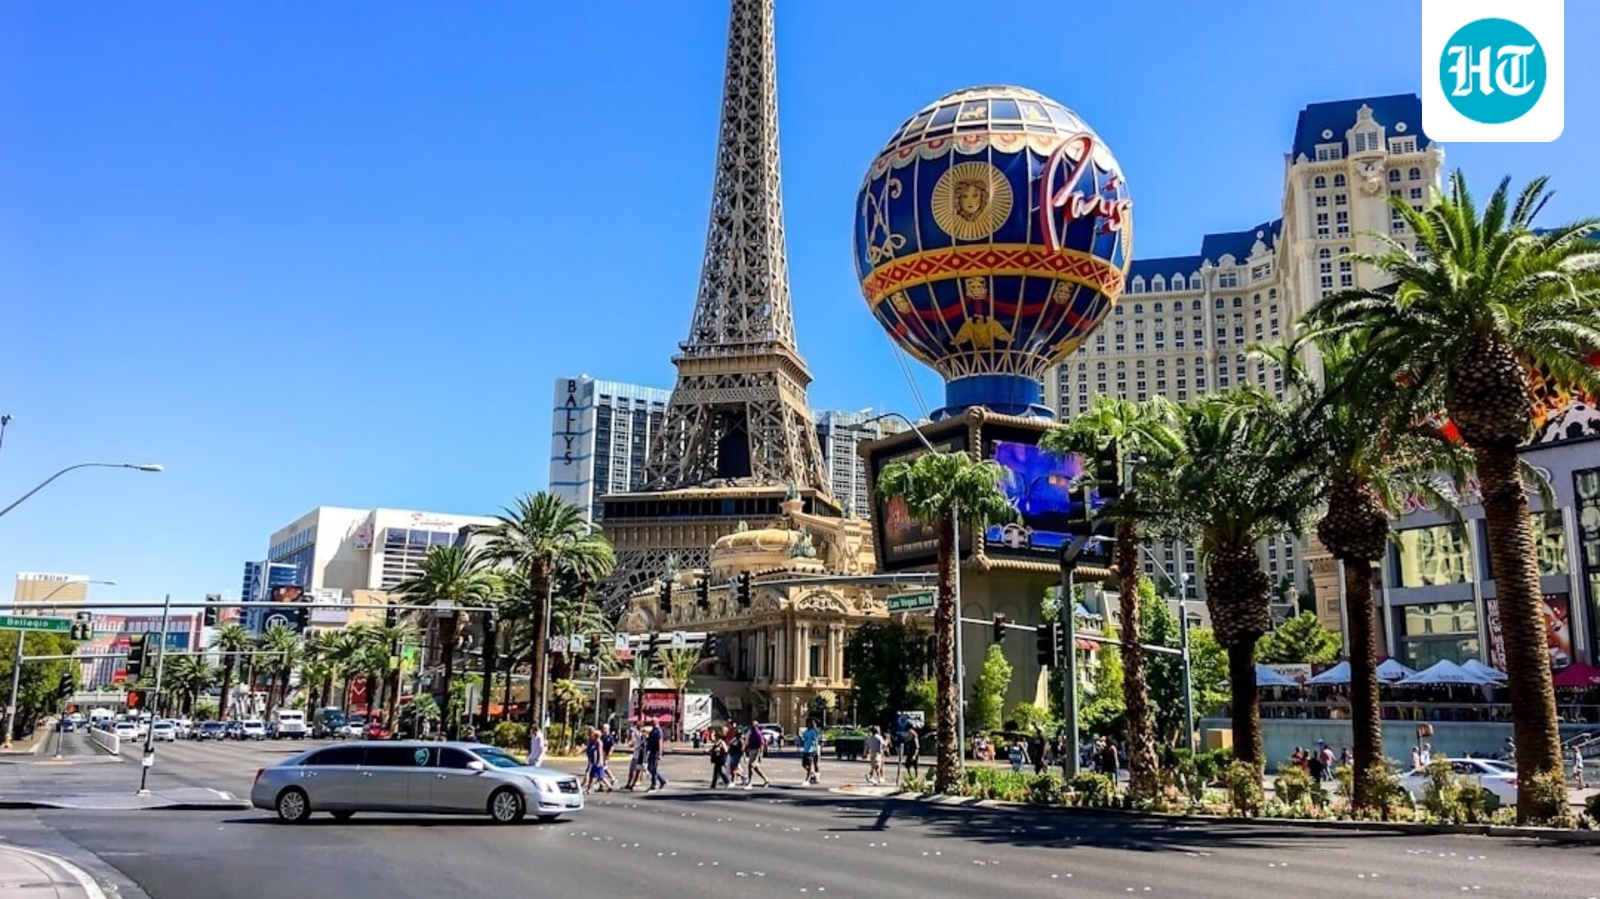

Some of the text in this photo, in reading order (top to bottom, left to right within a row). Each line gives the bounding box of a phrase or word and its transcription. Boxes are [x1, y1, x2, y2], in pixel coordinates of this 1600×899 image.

[1039, 131, 1132, 254] Paris
[900, 598, 917, 609] Vegas
[6, 618, 49, 629] Bellagio
